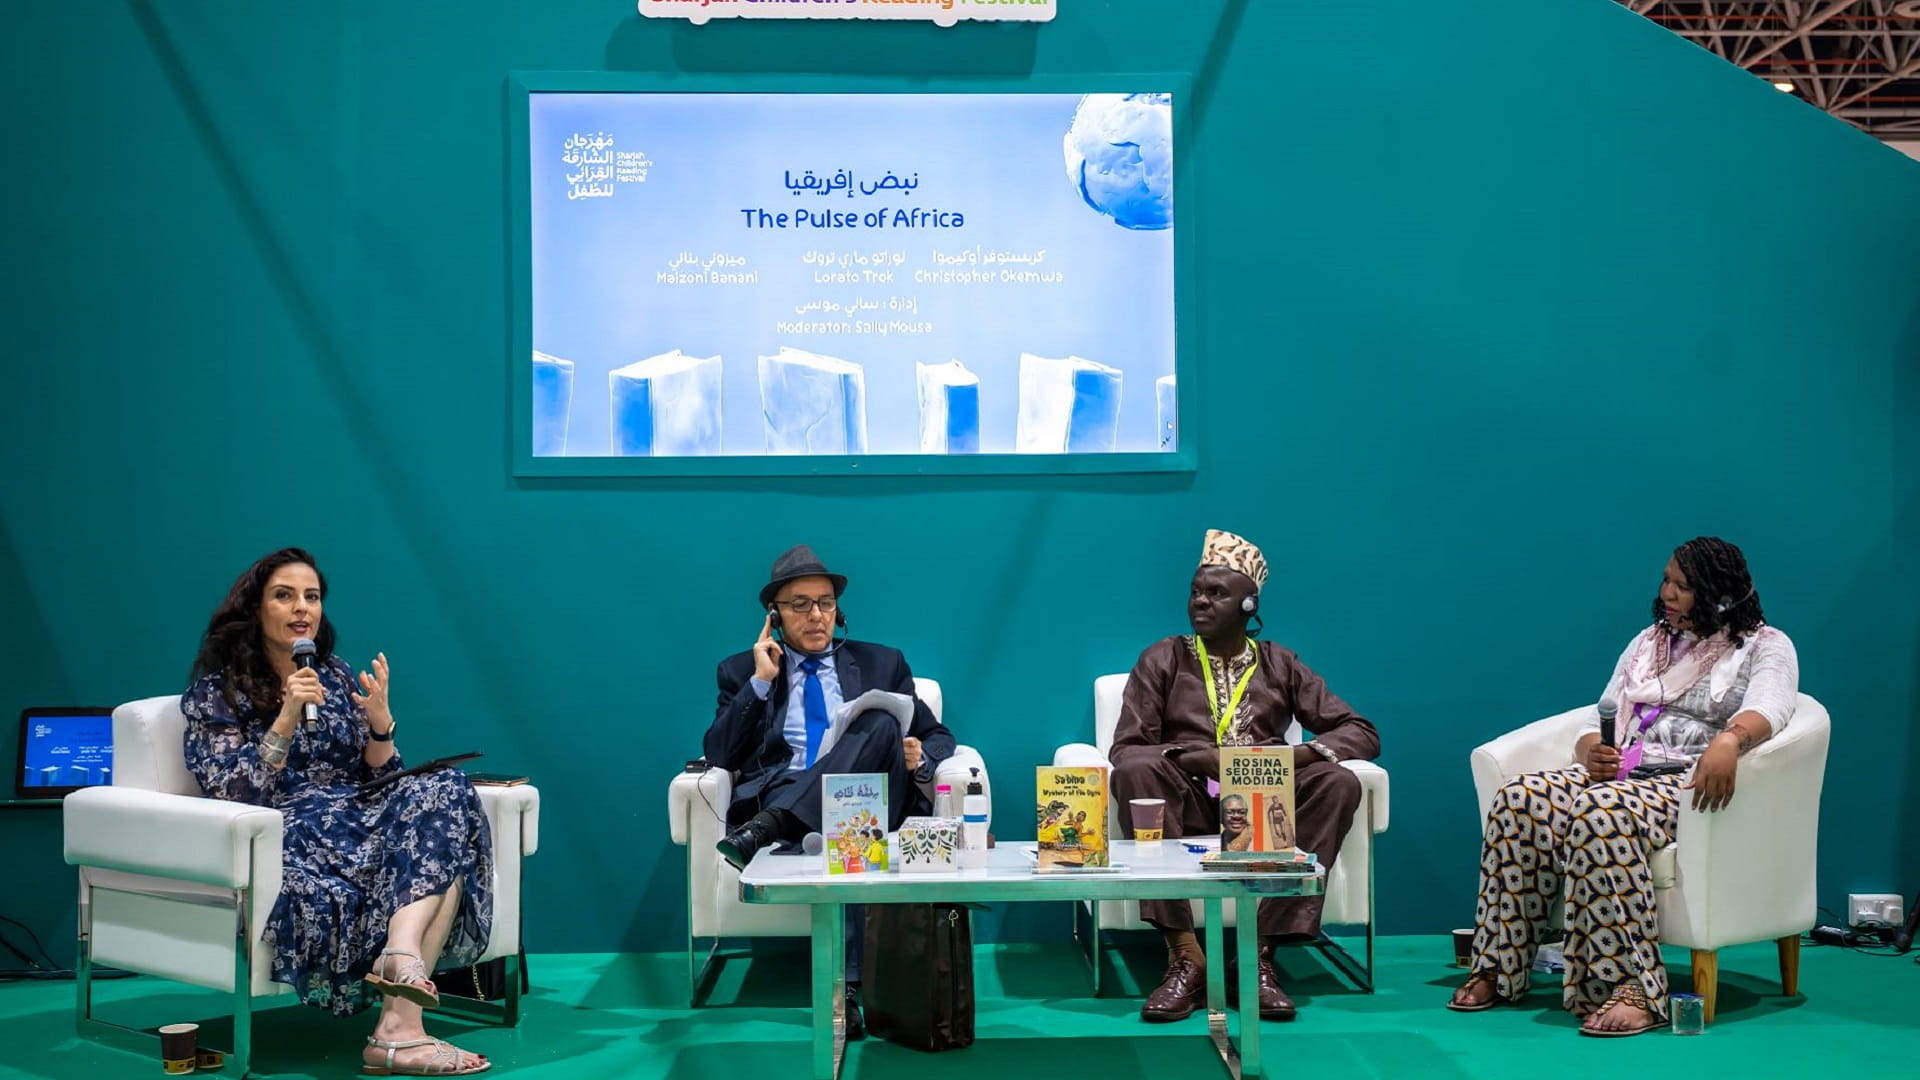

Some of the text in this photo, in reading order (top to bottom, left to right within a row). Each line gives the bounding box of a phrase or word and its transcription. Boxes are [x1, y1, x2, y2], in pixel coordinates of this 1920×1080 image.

[785, 168, 919, 198] نبض إفريقيا
[741, 207, 965, 229] The Pulse of Africa
[702, 252, 746, 271] ميزوني
[802, 250, 906, 268] لوراتو ماري تروك
[983, 248, 1047, 266] كريستوفر
[657, 270, 758, 284] Maizoni Banani
[814, 270, 894, 283] Lorato Trok
[914, 268, 1065, 286] Christopher Okemwa
[844, 296, 880, 318] سالي
[776, 320, 933, 336] Moderator: Sally Mousa
[1225, 767, 1289, 776] SEDIBANE
[1233, 758, 1282, 768] ROSINA
[1055, 774, 1086, 784] Sabina
[1232, 776, 1284, 785] MODIBA
